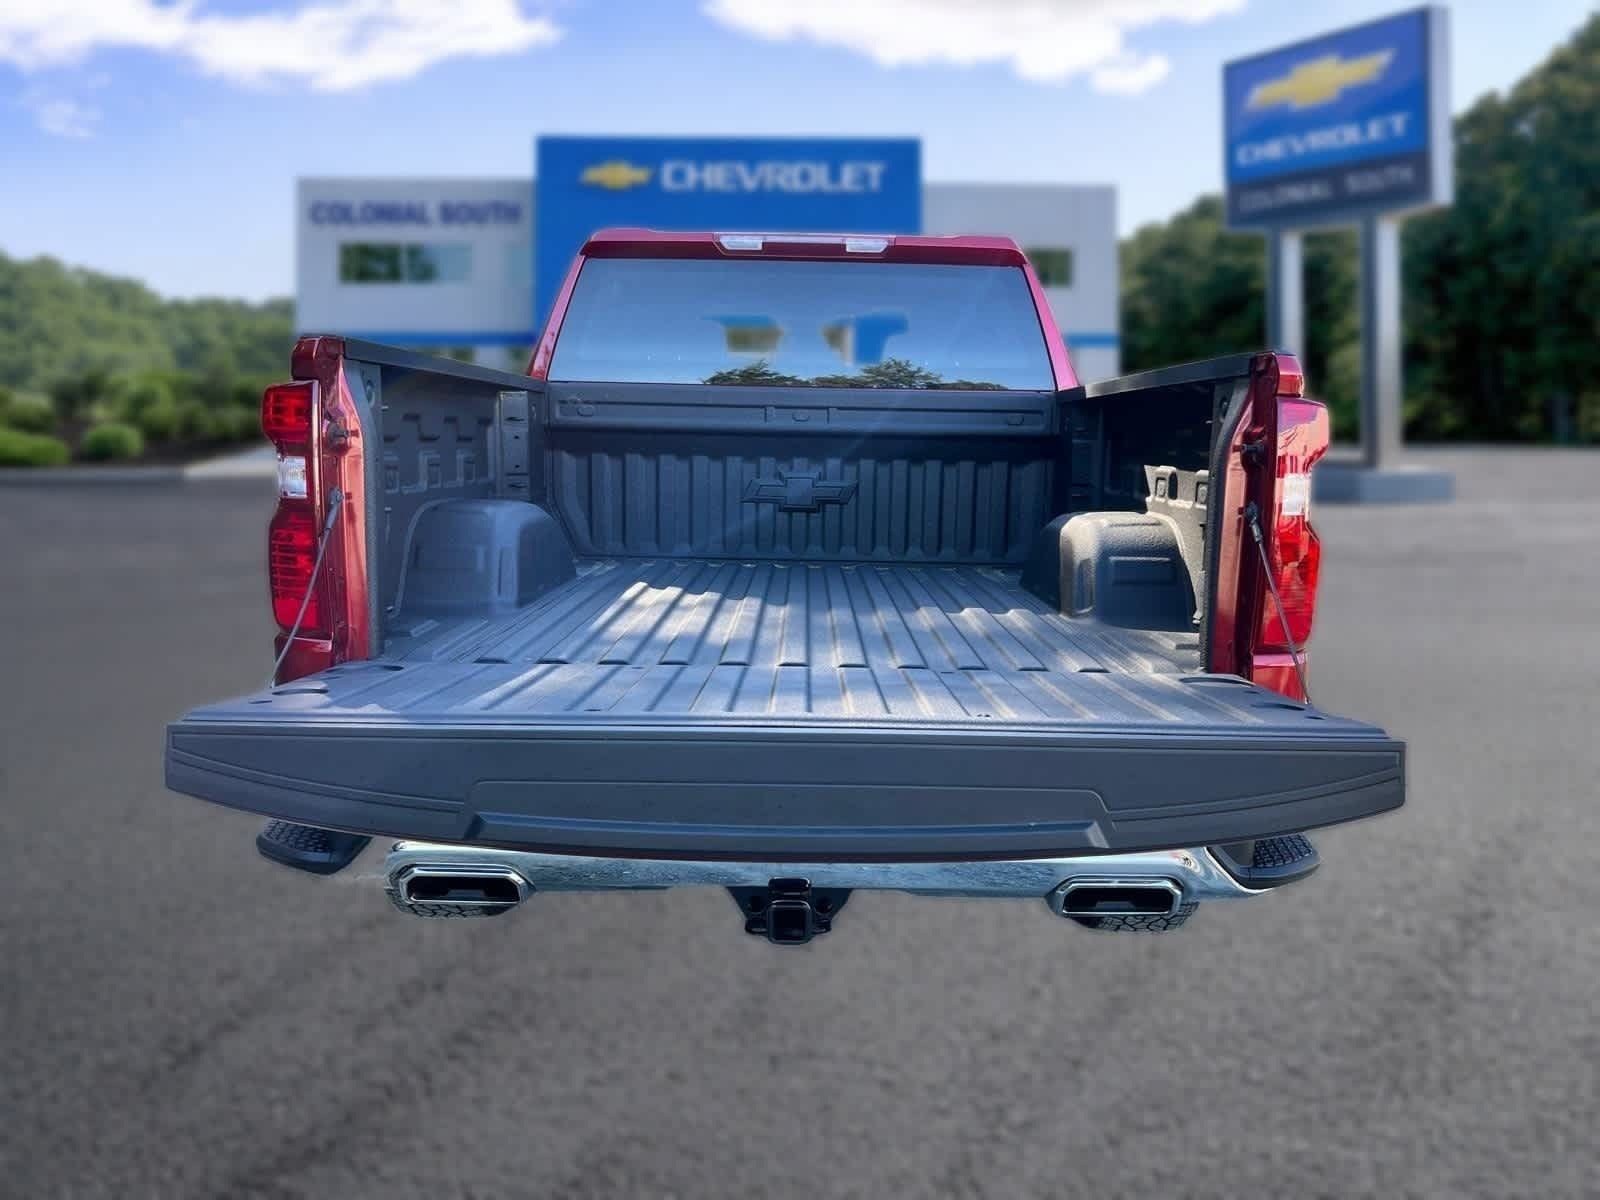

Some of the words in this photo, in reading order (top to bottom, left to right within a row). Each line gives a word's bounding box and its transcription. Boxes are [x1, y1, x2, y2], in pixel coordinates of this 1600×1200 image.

[1236, 112, 1409, 167] CHEVROLET
[660, 160, 886, 192] CHEVROLET
[309, 201, 430, 226] COLONIAL
[439, 201, 522, 226] SOUTH
